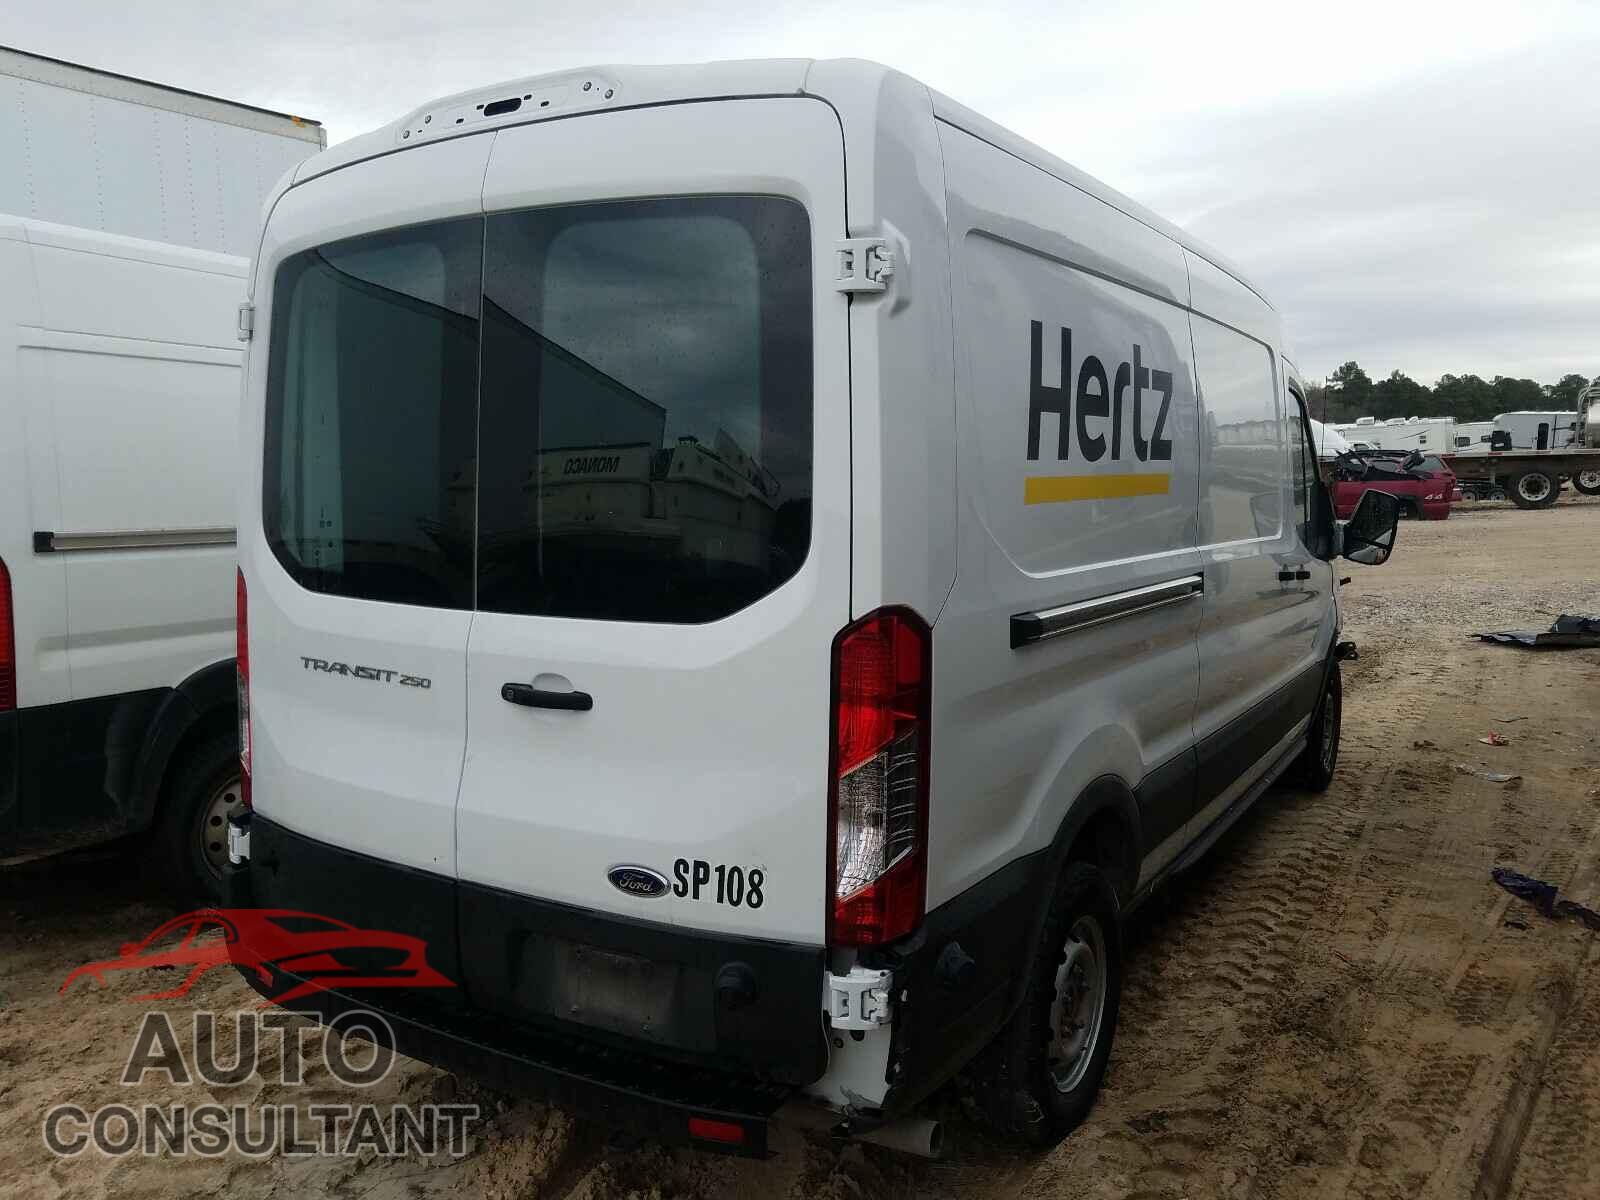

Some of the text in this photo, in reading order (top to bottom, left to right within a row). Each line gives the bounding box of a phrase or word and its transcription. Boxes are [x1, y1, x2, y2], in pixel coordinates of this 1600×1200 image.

[1027, 320, 1172, 462] Hertz
[301, 657, 431, 689] TRANSIT 250
[619, 871, 654, 892] Ford
[673, 858, 764, 909] SP108
